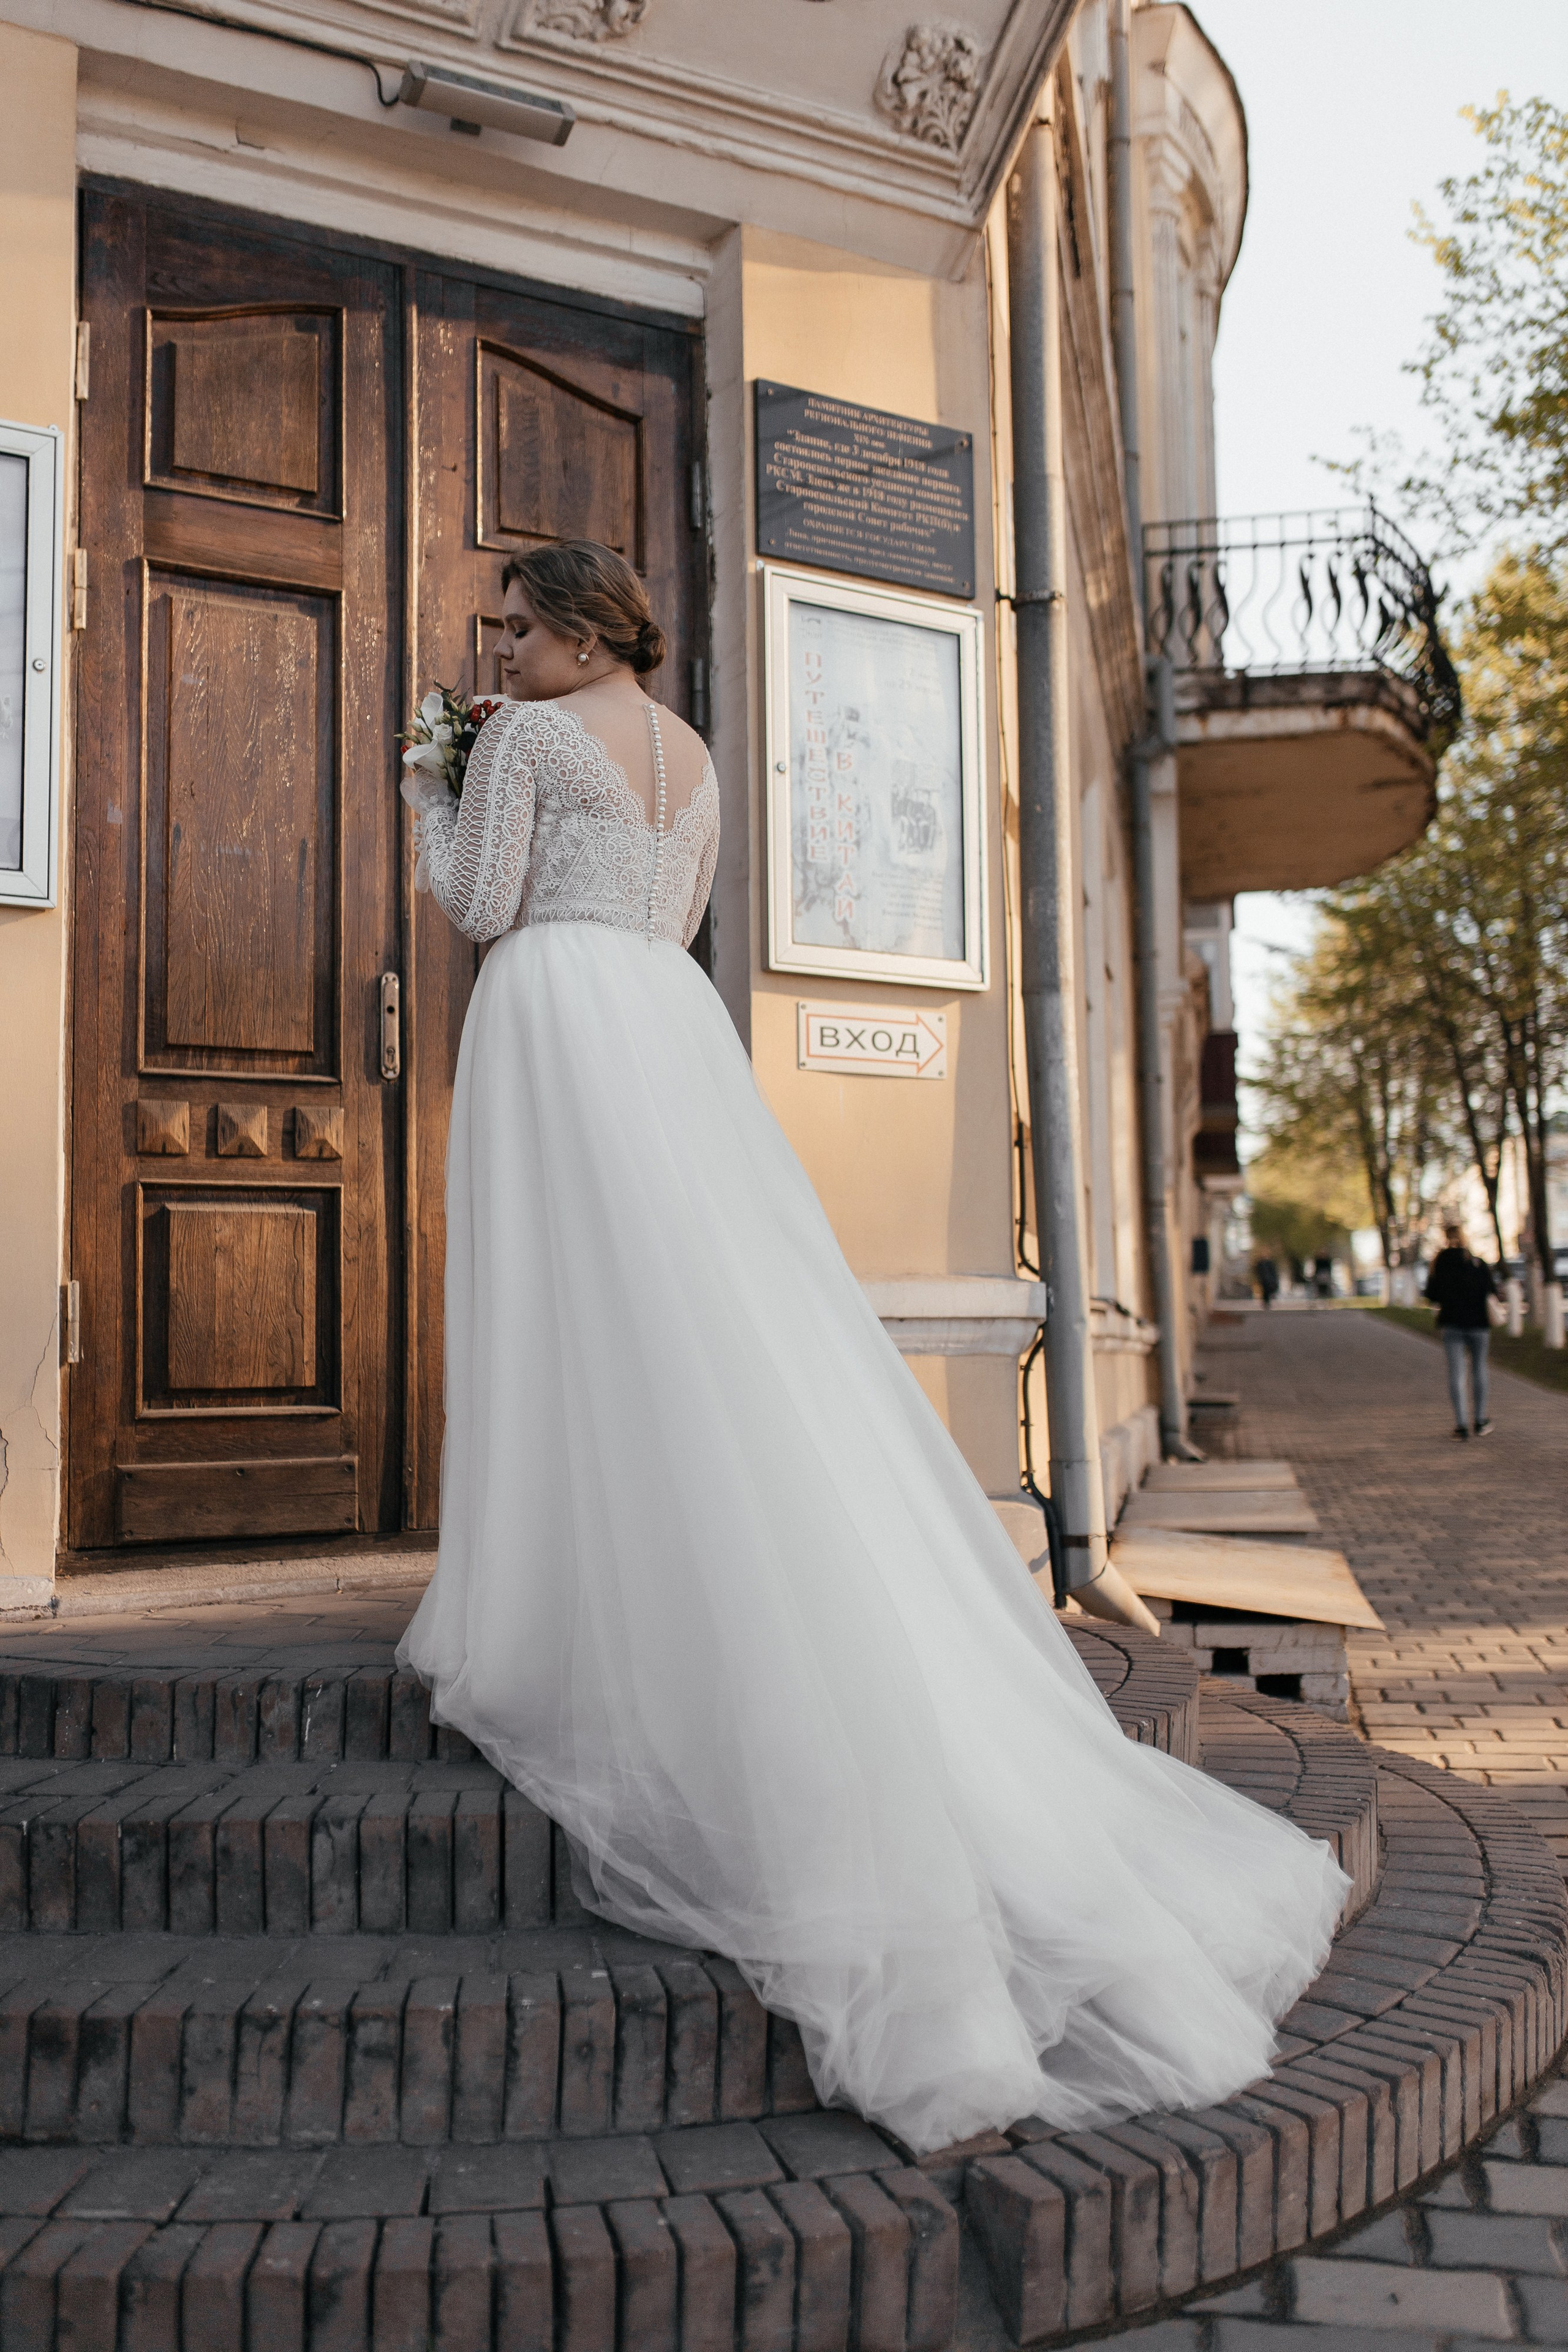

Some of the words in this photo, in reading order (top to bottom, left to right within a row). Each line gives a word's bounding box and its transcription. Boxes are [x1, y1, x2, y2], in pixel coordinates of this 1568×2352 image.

[804, 407, 884, 437] РЕГИОНАЛЬНОГО
[886, 428, 932, 450] ЗНАЧЕНИЯ
[808, 396, 861, 420] ПАМЯТНИК
[861, 410, 929, 437] АРХИТЕКТУРЫ
[773, 451, 870, 486] Старооскольского
[870, 477, 913, 498] уездного
[914, 487, 962, 508] комитета
[774, 440, 832, 463] состоялось
[834, 454, 869, 474] первое
[872, 464, 919, 484] заседание
[834, 441, 850, 454] где
[851, 443, 859, 457] 3
[860, 446, 902, 469] декабря
[927, 465, 949, 479] года
[775, 478, 869, 513] Старооскольский
[870, 500, 913, 521] Комитет
[952, 522, 960, 532] и
[806, 472, 834, 490] Здесь
[836, 481, 850, 494] же
[852, 485, 859, 496] в
[886, 494, 908, 510] году
[803, 498, 855, 522] городской
[857, 510, 888, 529] Совет
[803, 517, 863, 539] ОХРАНЯЕТСЯ
[864, 530, 937, 555] ГОСУДАРСТВОМ
[805, 652, 826, 860] ПУТЕШЕСТВИЕ
[837, 752, 853, 771] В
[820, 1026, 919, 1058] ВХОД
